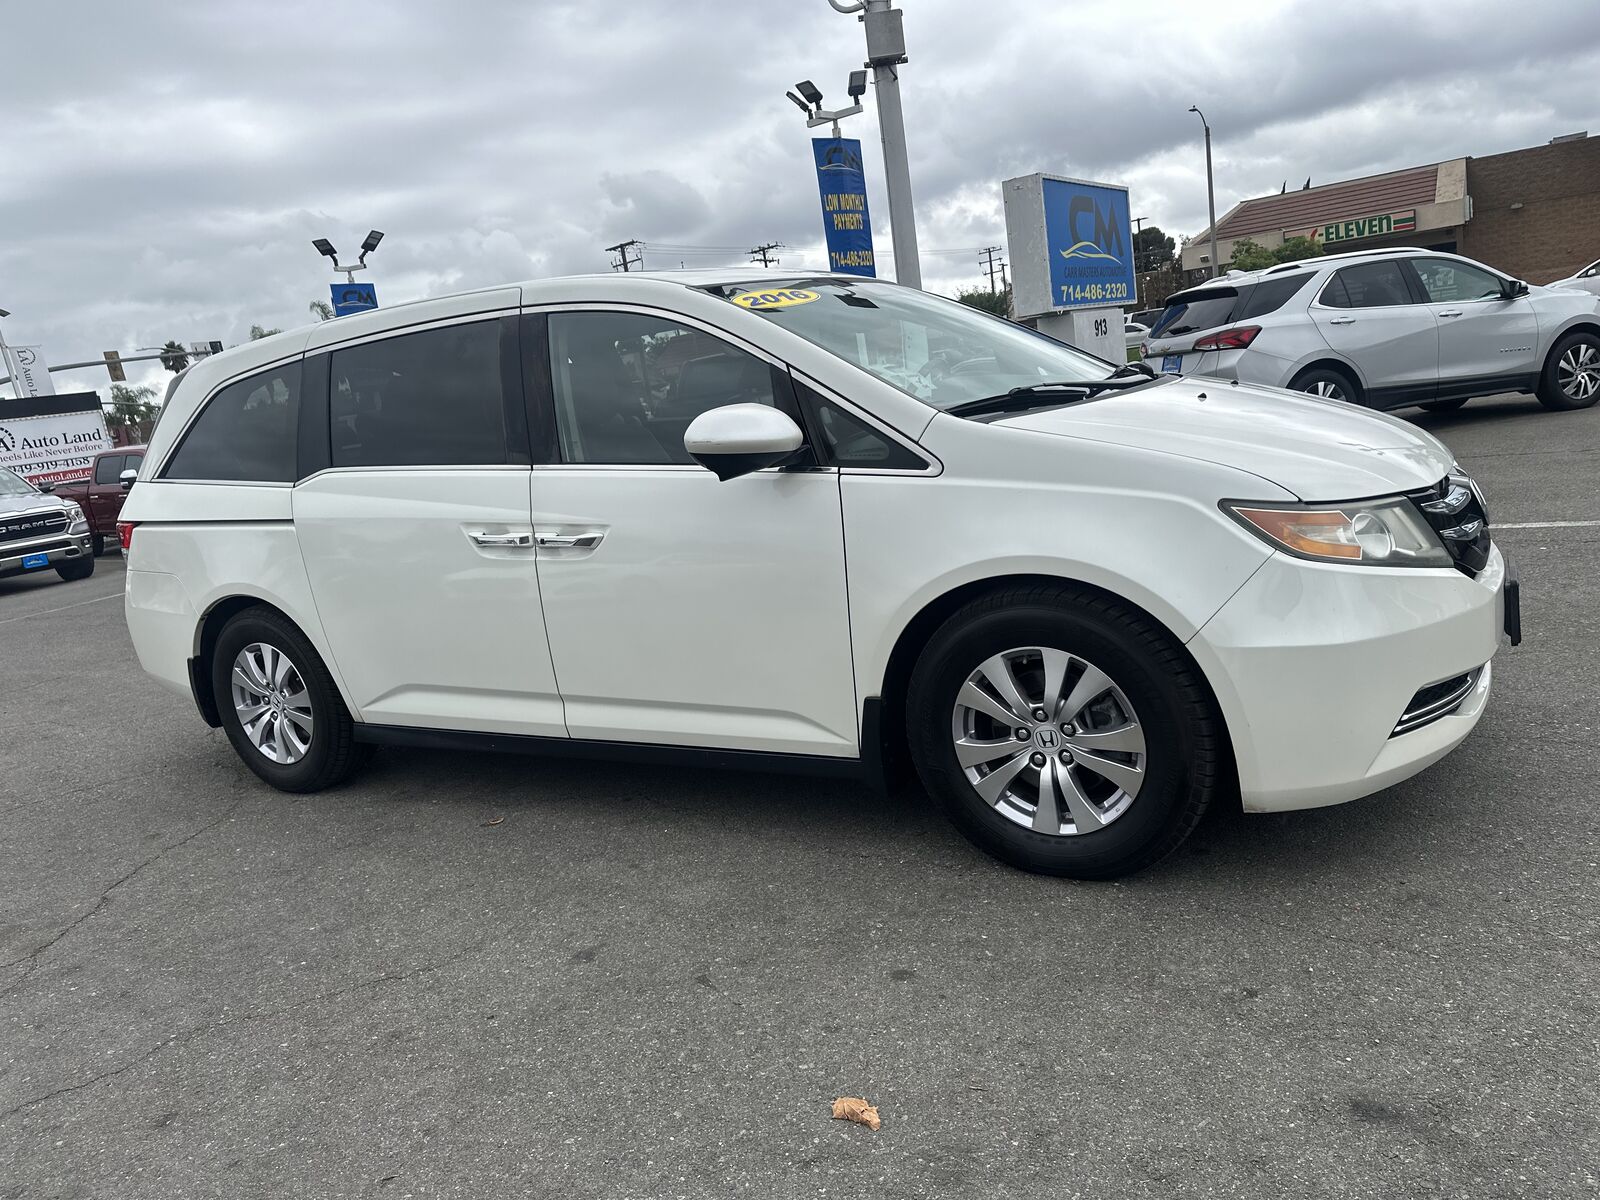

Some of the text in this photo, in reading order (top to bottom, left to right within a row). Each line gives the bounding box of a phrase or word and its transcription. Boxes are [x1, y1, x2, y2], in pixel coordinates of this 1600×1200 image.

[824, 193, 865, 211] LOW MONTHLY
[833, 213, 863, 231] PAYMENTS
[831, 250, 873, 268] 714-486-2320
[742, 287, 811, 307] 2016
[1061, 282, 1127, 302] 714-486-2320
[1094, 318, 1108, 337] 913
[23, 367, 34, 387] Auto
[21, 436, 59, 450] Auto
[62, 428, 102, 445] Land
[23, 451, 43, 460] Like
[45, 447, 73, 457] Never
[73, 443, 103, 453] Before
[8, 521, 44, 531] RAM
